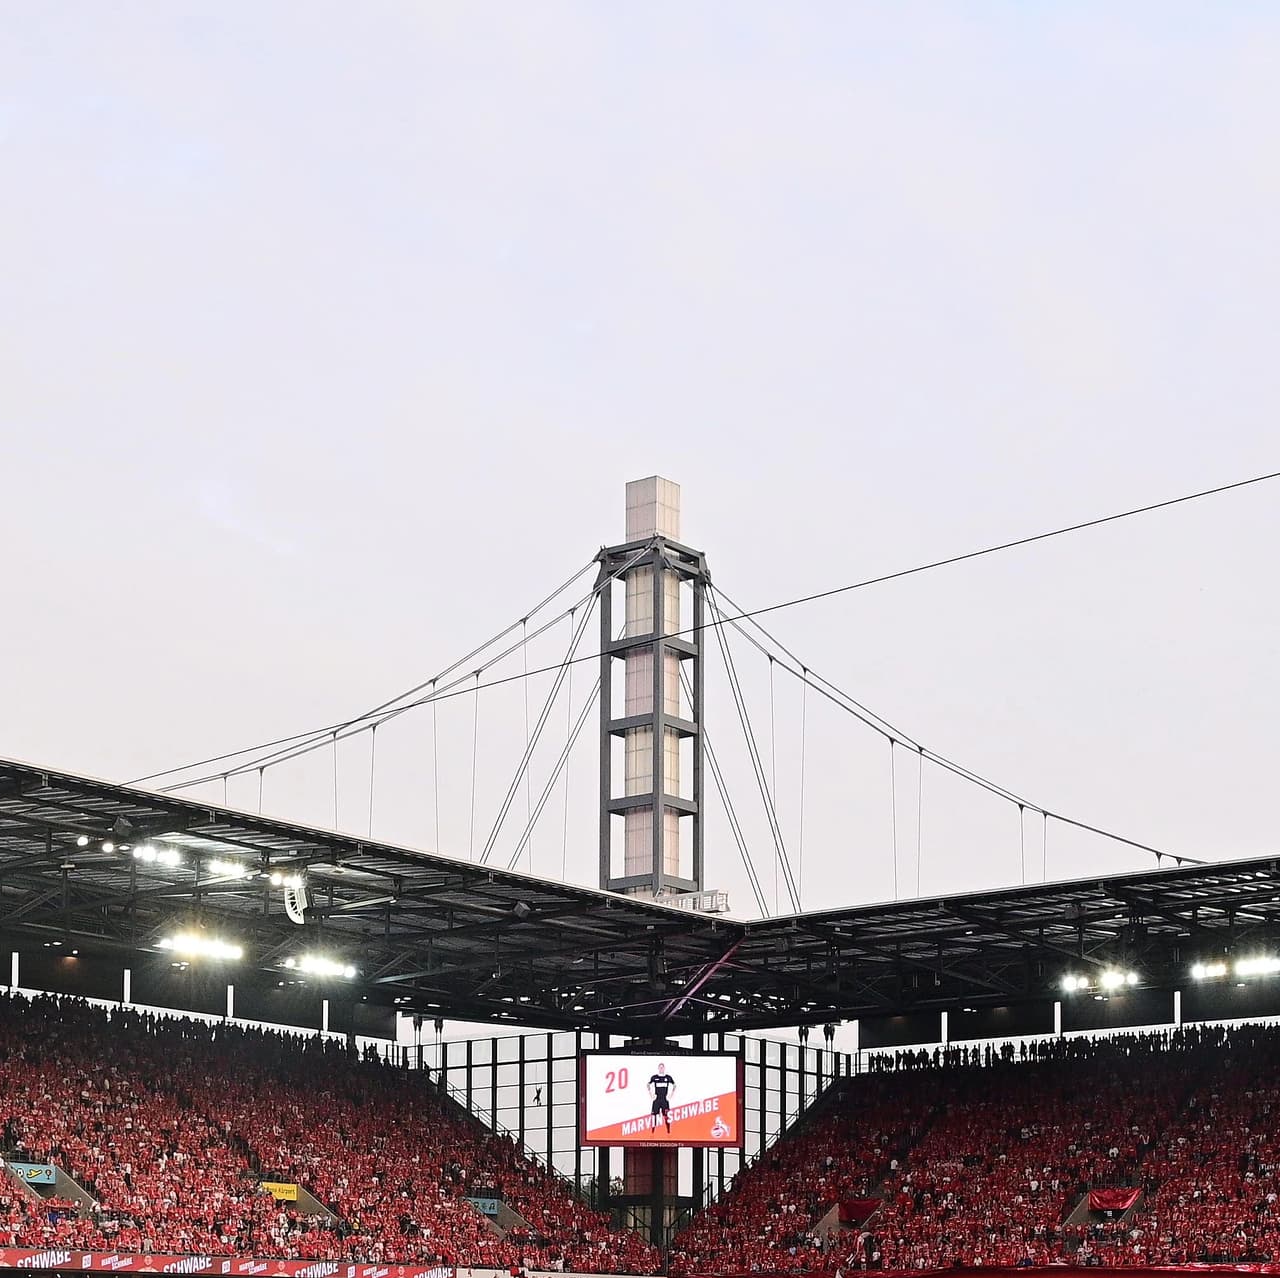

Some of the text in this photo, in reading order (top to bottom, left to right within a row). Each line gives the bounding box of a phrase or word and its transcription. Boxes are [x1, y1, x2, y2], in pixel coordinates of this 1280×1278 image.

[605, 1068, 628, 1094] 20
[622, 1098, 719, 1136] MARVIN SCHWÄBE
